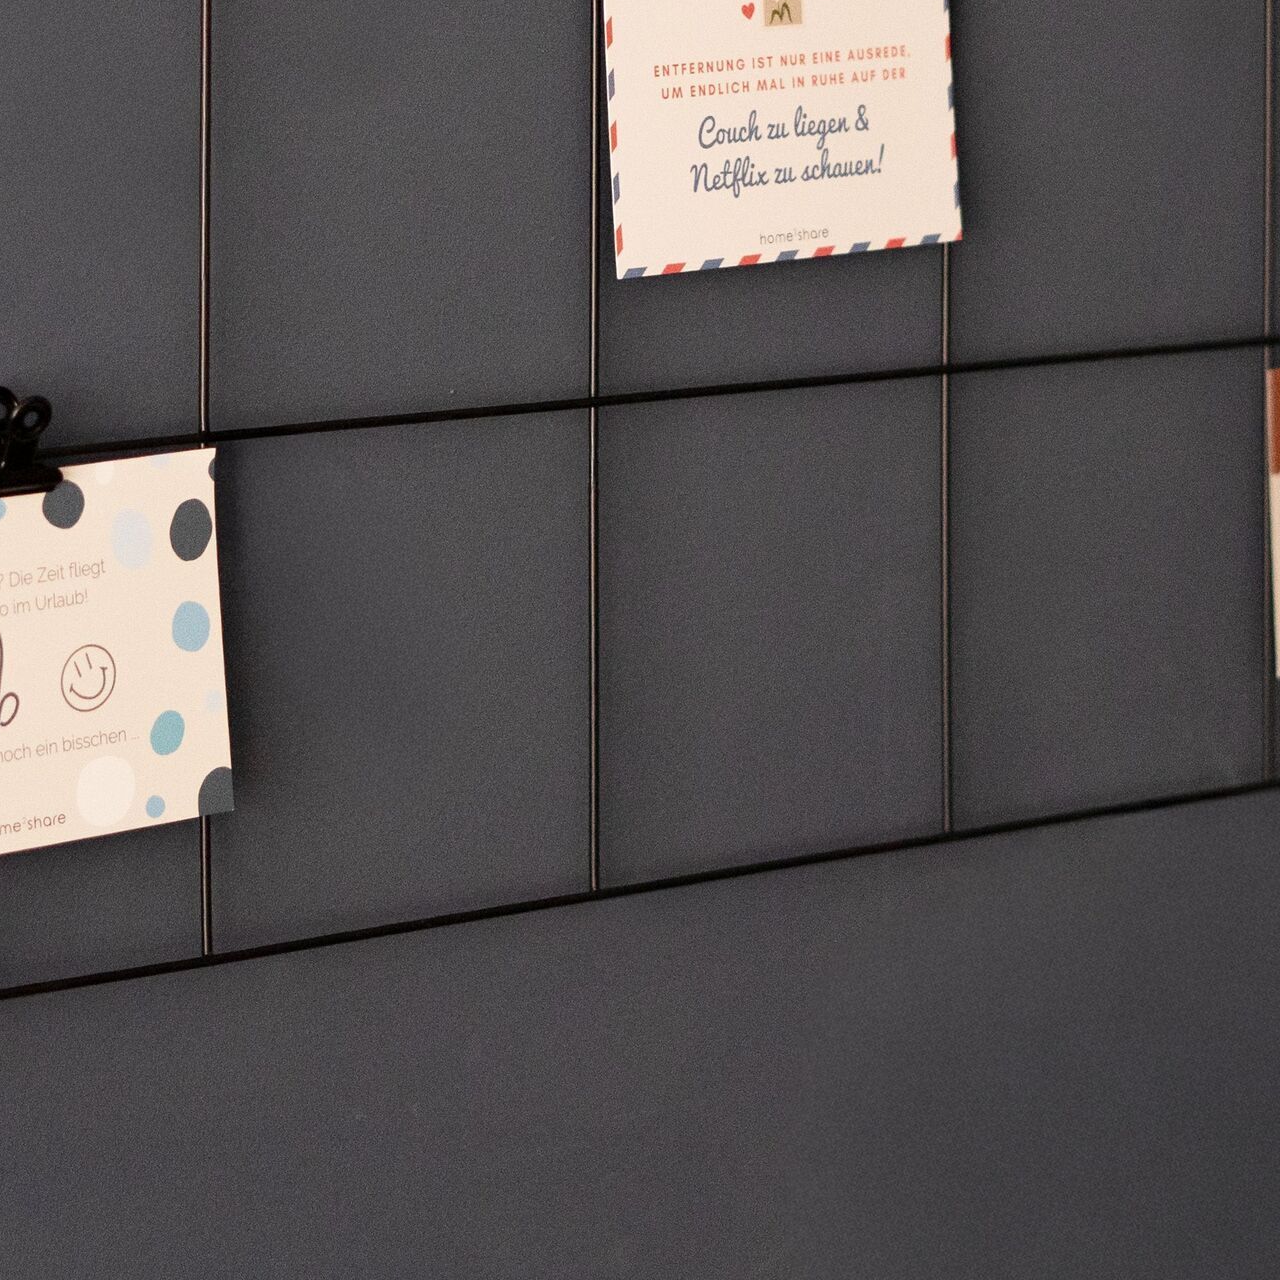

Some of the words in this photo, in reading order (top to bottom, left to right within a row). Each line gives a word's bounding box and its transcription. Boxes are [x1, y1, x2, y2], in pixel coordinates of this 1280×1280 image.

[653, 58, 746, 78] ENTFERNUNG
[751, 55, 773, 69] IST
[780, 52, 807, 67] NUR
[812, 50, 841, 64] EINE
[661, 85, 683, 100] UM
[690, 80, 750, 98] ENDLICH
[756, 77, 786, 92] MAL
[791, 74, 806, 89] IN
[811, 72, 845, 87] RUHE
[851, 69, 876, 83] AUF
[882, 67, 906, 80] DER
[698, 109, 762, 149] Couch
[767, 122, 790, 139] zu
[794, 104, 850, 150] liegen
[854, 103, 870, 131] &
[690, 155, 769, 199] Netflix
[774, 166, 797, 185] zu
[801, 143, 885, 182] schauen!
[8, 570, 33, 588] Die
[37, 565, 65, 584] Zeit
[69, 559, 106, 580] fliegt
[12, 598, 32, 614] im
[35, 589, 89, 612] Urlaub!
[35, 738, 59, 757] ein
[62, 729, 127, 753] bisschen
